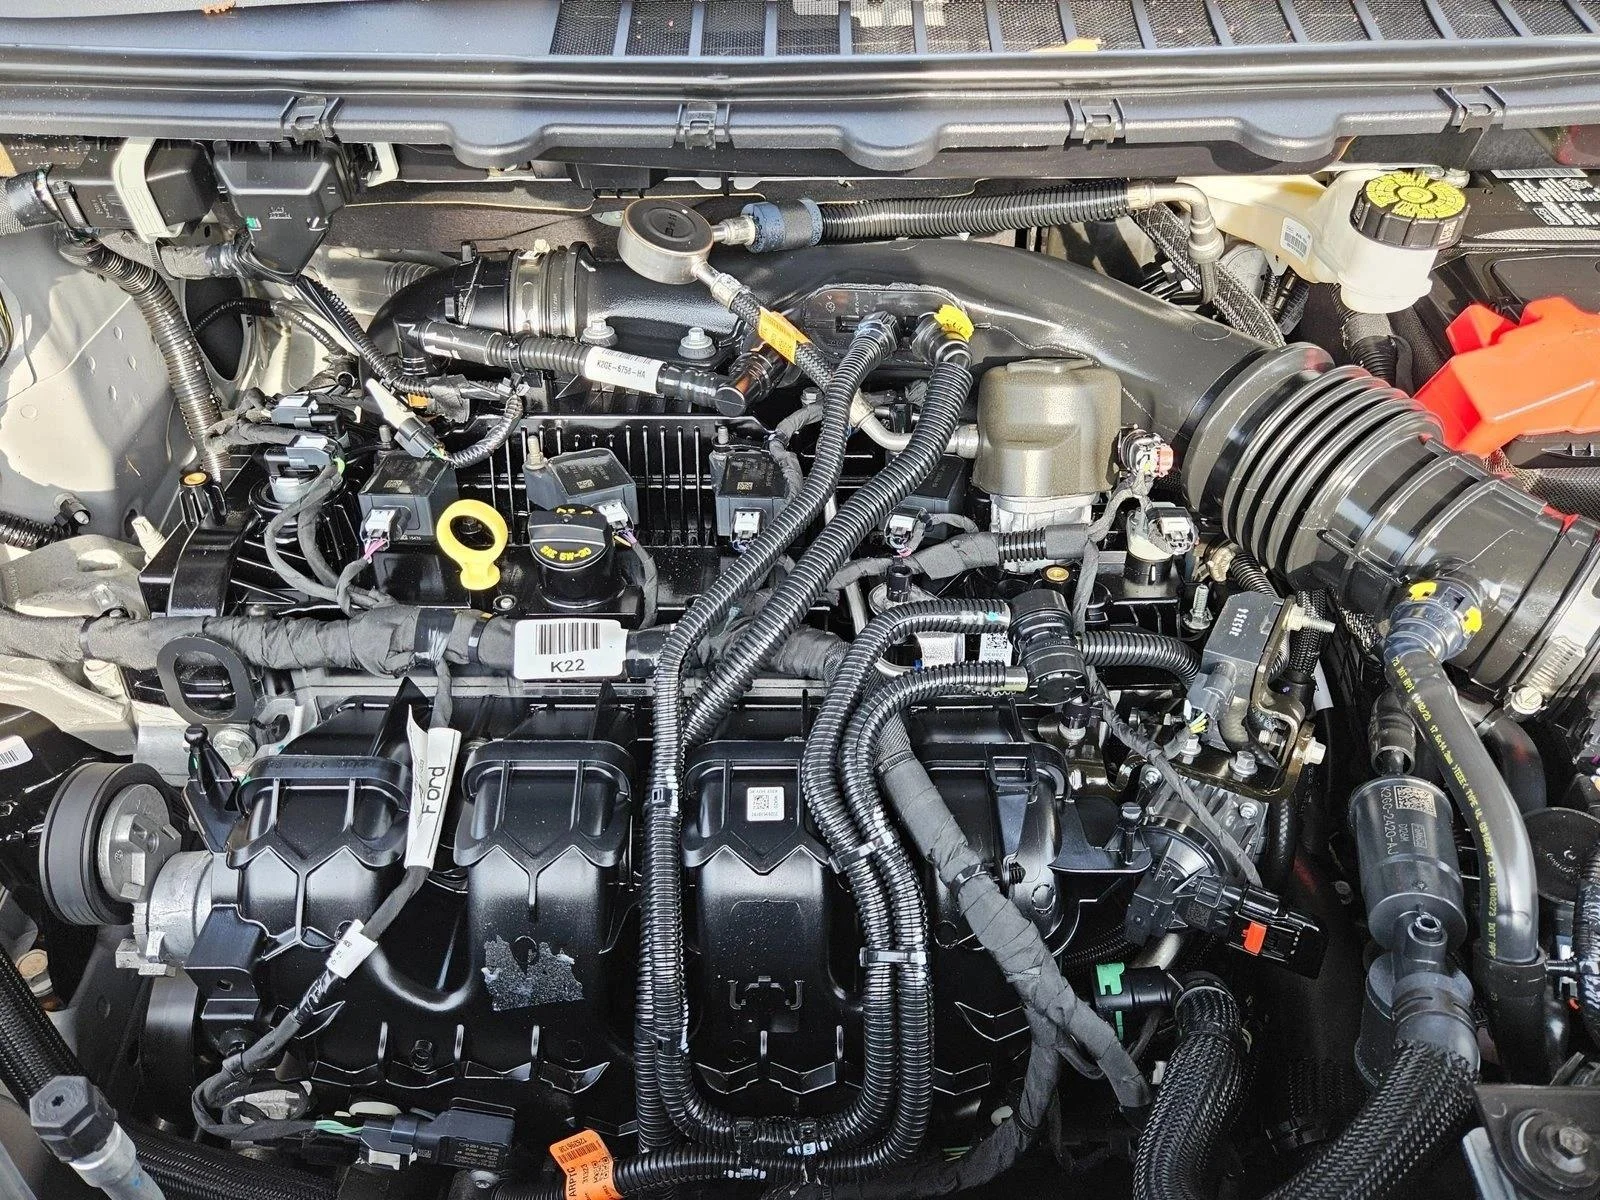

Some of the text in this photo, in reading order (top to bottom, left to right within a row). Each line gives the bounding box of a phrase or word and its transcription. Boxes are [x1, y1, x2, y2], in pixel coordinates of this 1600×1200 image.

[540, 545, 592, 561] SAE 5W-30
[550, 658, 585, 673] K22
[421, 766, 447, 814] Ford
[1465, 787, 1479, 808] TYPE
[1474, 808, 1483, 821] UL
[1488, 922, 1497, 939] DOT
